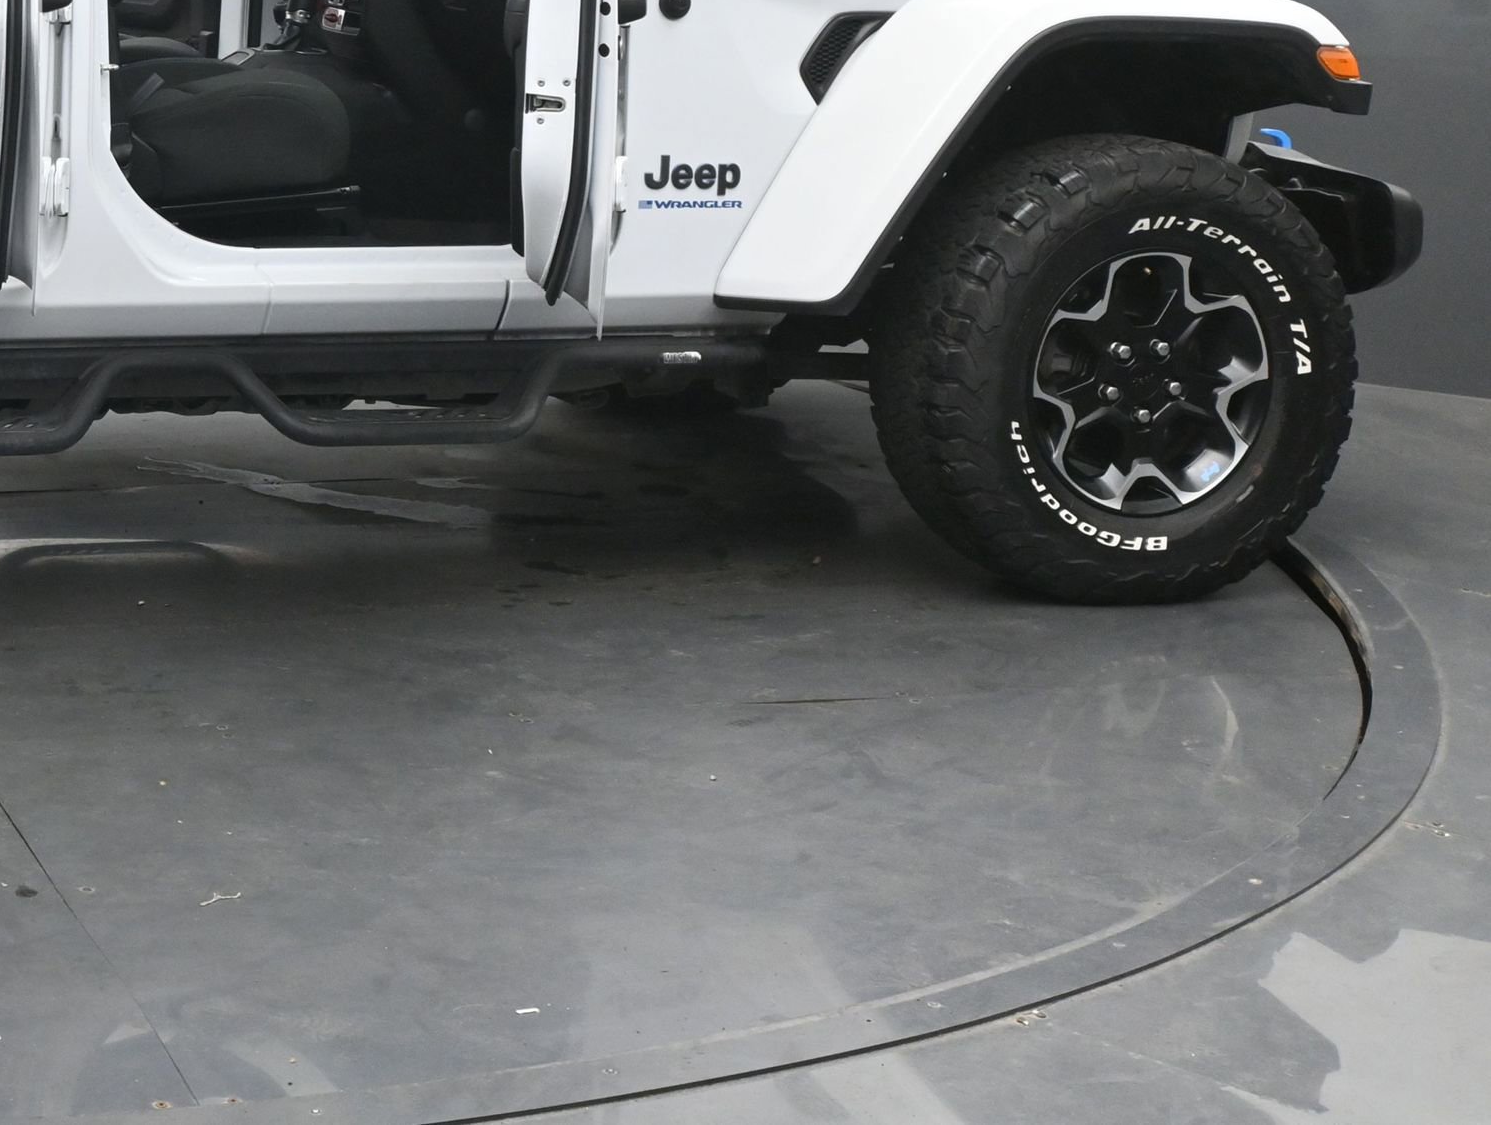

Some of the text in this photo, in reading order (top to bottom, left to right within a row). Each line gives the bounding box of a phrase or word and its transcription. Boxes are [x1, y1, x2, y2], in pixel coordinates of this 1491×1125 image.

[644, 155, 741, 196] Jeep
[654, 199, 742, 209] WRANGLER
[1128, 215, 1312, 375] All-Terrain T/A
[1010, 420, 1168, 551] BFGoodrich
